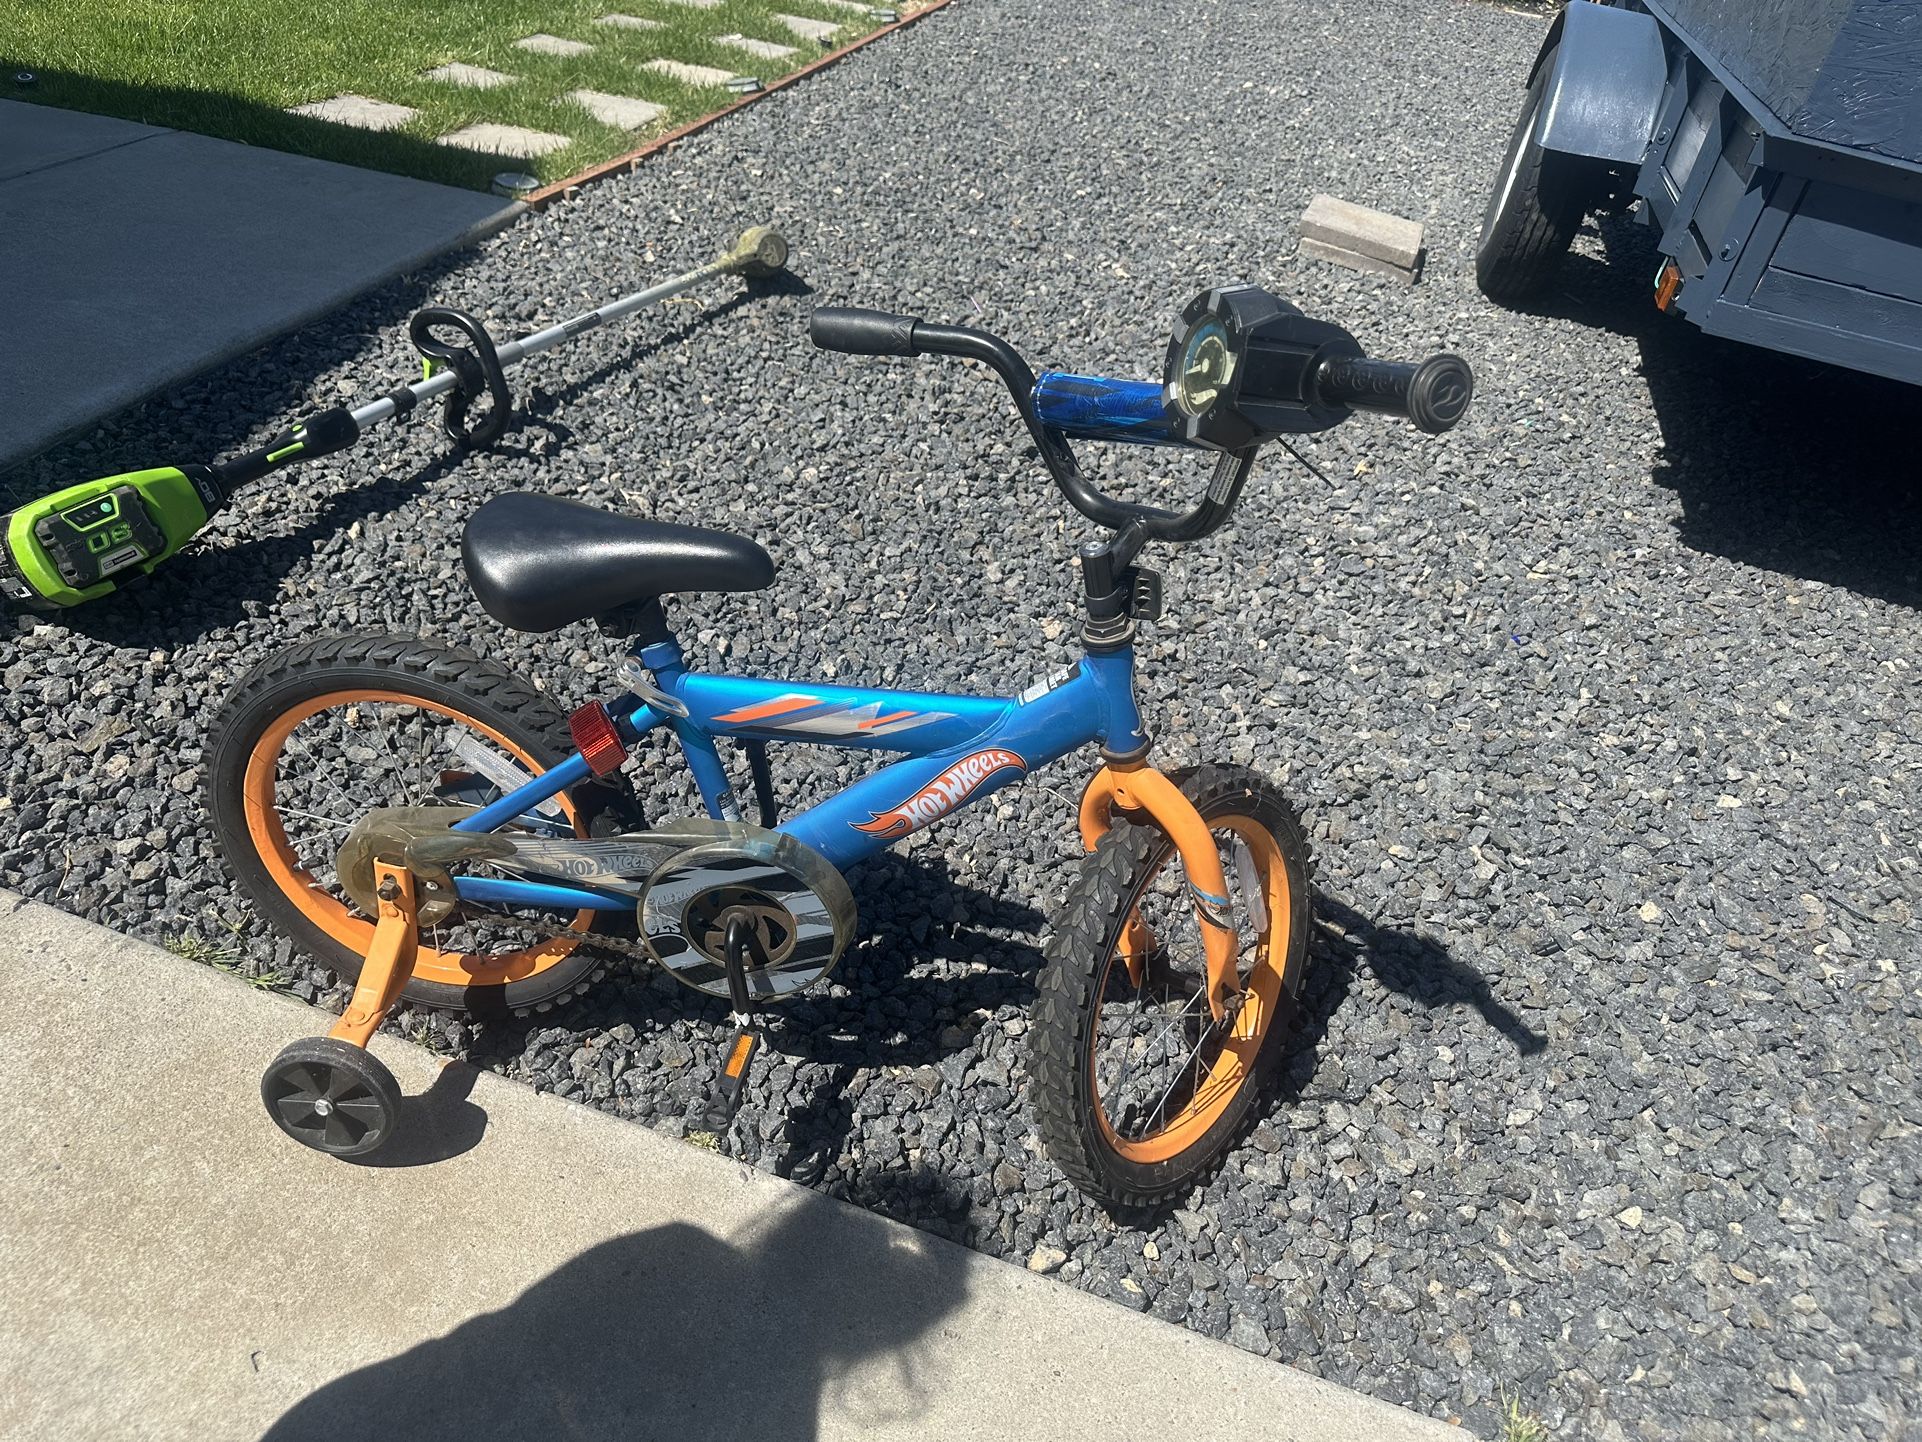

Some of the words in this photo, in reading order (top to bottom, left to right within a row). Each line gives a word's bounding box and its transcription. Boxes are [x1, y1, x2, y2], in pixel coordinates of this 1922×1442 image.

[896, 790, 948, 828] HOT
[935, 751, 1010, 804] WHeeLs
[557, 858, 597, 876] HOT
